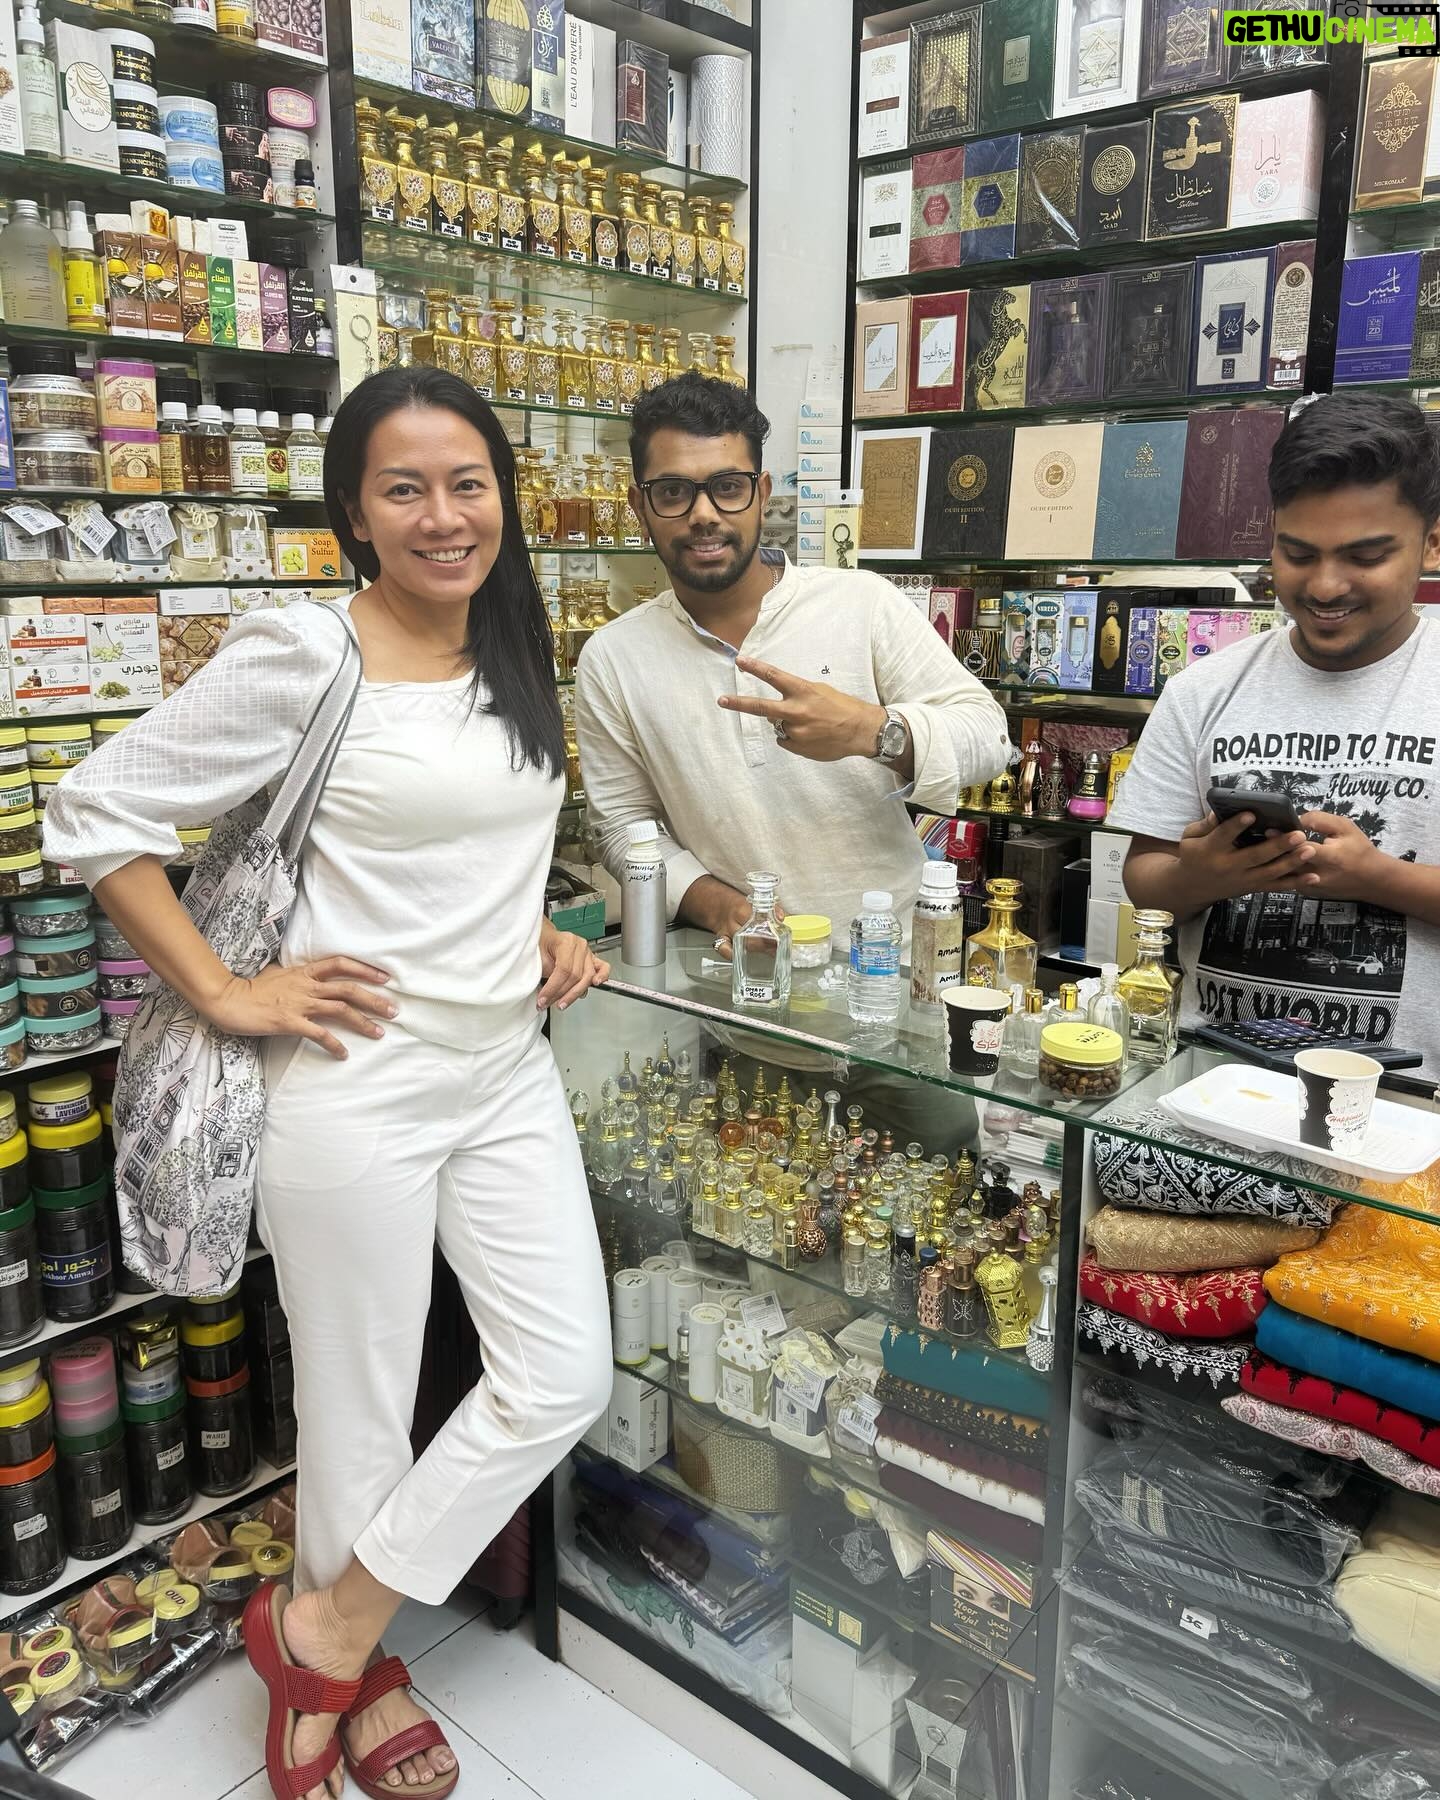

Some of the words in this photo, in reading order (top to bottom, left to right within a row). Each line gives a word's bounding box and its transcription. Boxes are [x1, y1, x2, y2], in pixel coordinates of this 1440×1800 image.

[312, 537, 332, 548] Soap
[311, 547, 335, 556] Sulfur
[821, 665, 831, 675] ck
[1212, 731, 1341, 764] ROADTRIP
[1346, 733, 1378, 759] TO
[68, 750, 89, 759] LEMON
[1324, 772, 1392, 806] Flurry
[1393, 775, 1431, 800] CO.
[8, 796, 29, 807] LEMON
[744, 986, 766, 994] OMAN
[1252, 990, 1392, 1043] WORLD
[68, 1267, 94, 1280] Amwaj
[165, 1590, 186, 1605] OUD
[952, 1597, 978, 1616] Noor
[953, 1608, 980, 1627] Kajal
